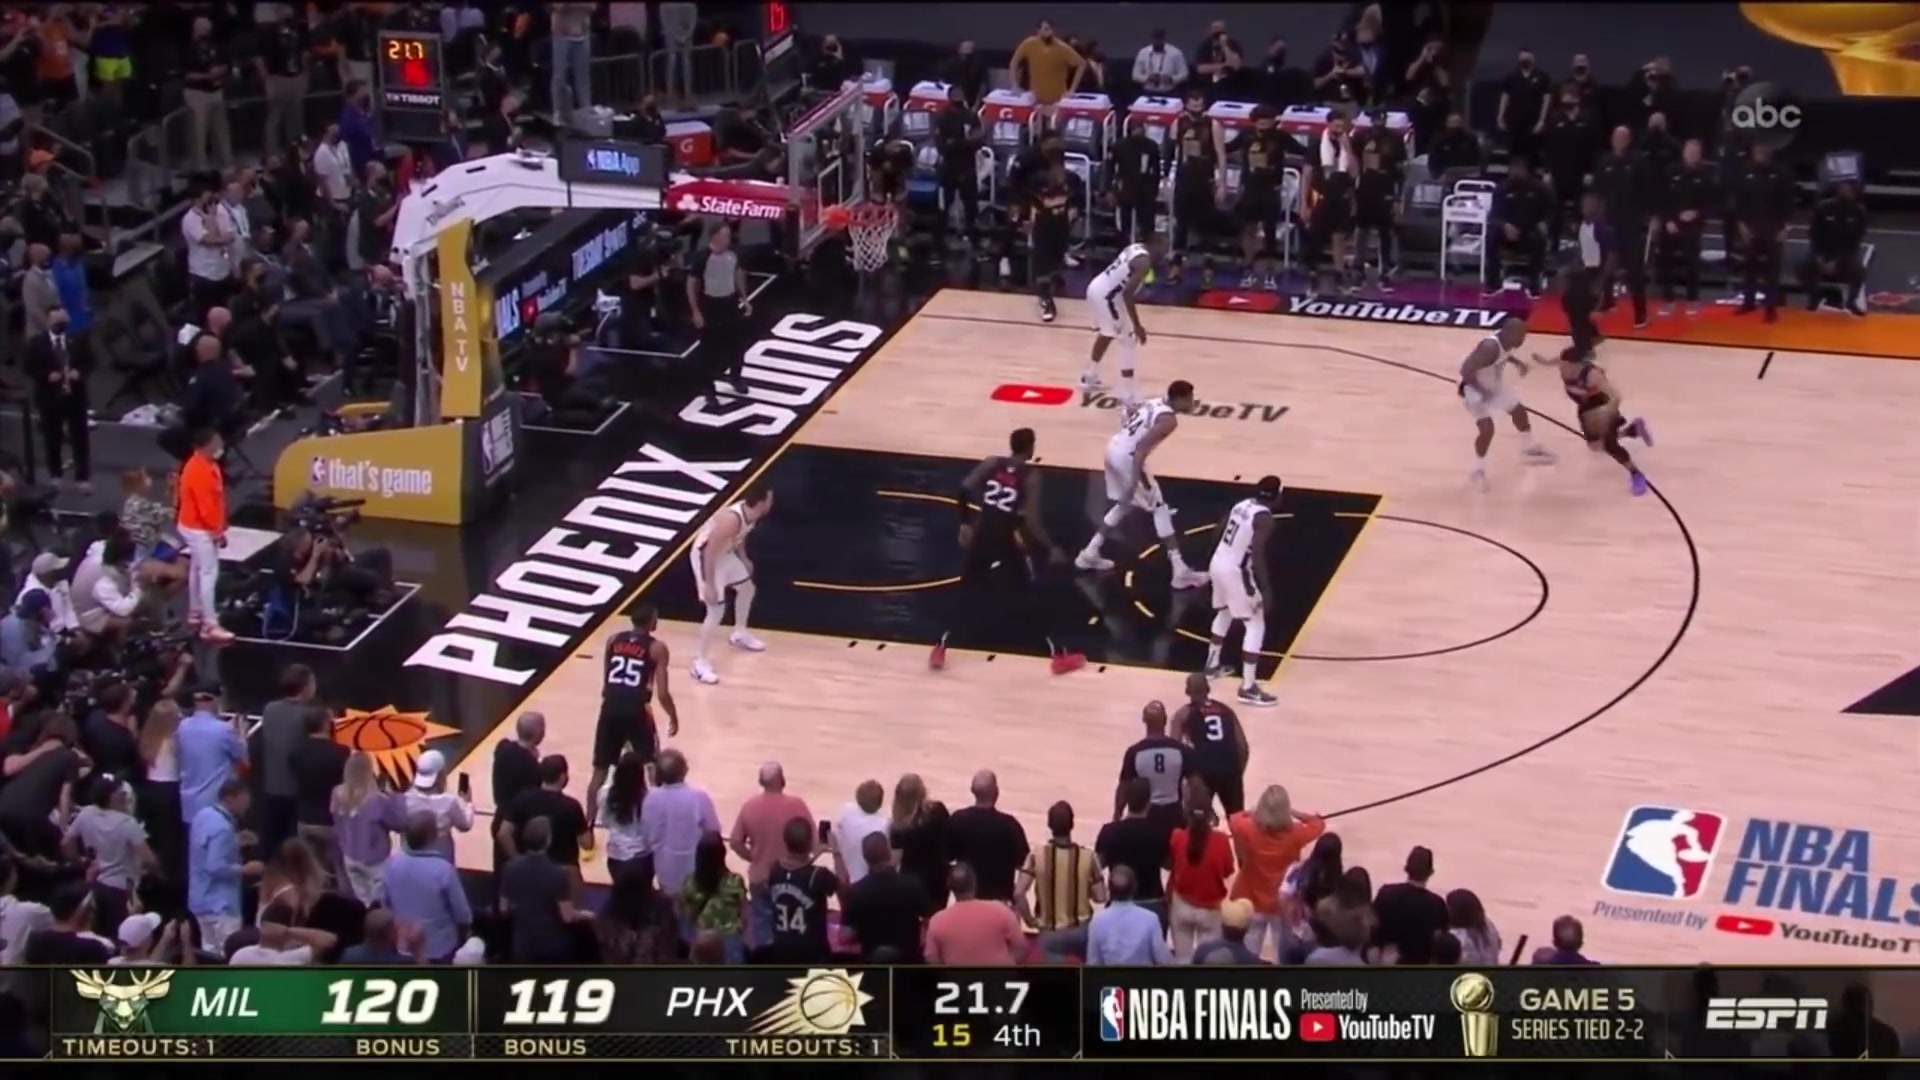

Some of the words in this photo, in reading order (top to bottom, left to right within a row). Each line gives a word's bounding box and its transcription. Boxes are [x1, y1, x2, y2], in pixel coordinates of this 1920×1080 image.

[597, 151, 621, 171] NBA
[451, 282, 467, 332] NBA
[455, 339, 469, 372] TV
[677, 313, 883, 436] SUNS
[329, 458, 378, 492] that's
[381, 467, 432, 497] game
[984, 480, 1017, 512] 22
[1223, 519, 1240, 547] 21
[402, 442, 752, 686] PHOENIX
[608, 655, 644, 687] 25
[1204, 715, 1223, 741] 3
[1154, 753, 1165, 774] 8
[1737, 817, 1870, 873] NBA
[775, 903, 807, 934] 34
[1592, 900, 1685, 928] Presented
[1686, 910, 1709, 932] by
